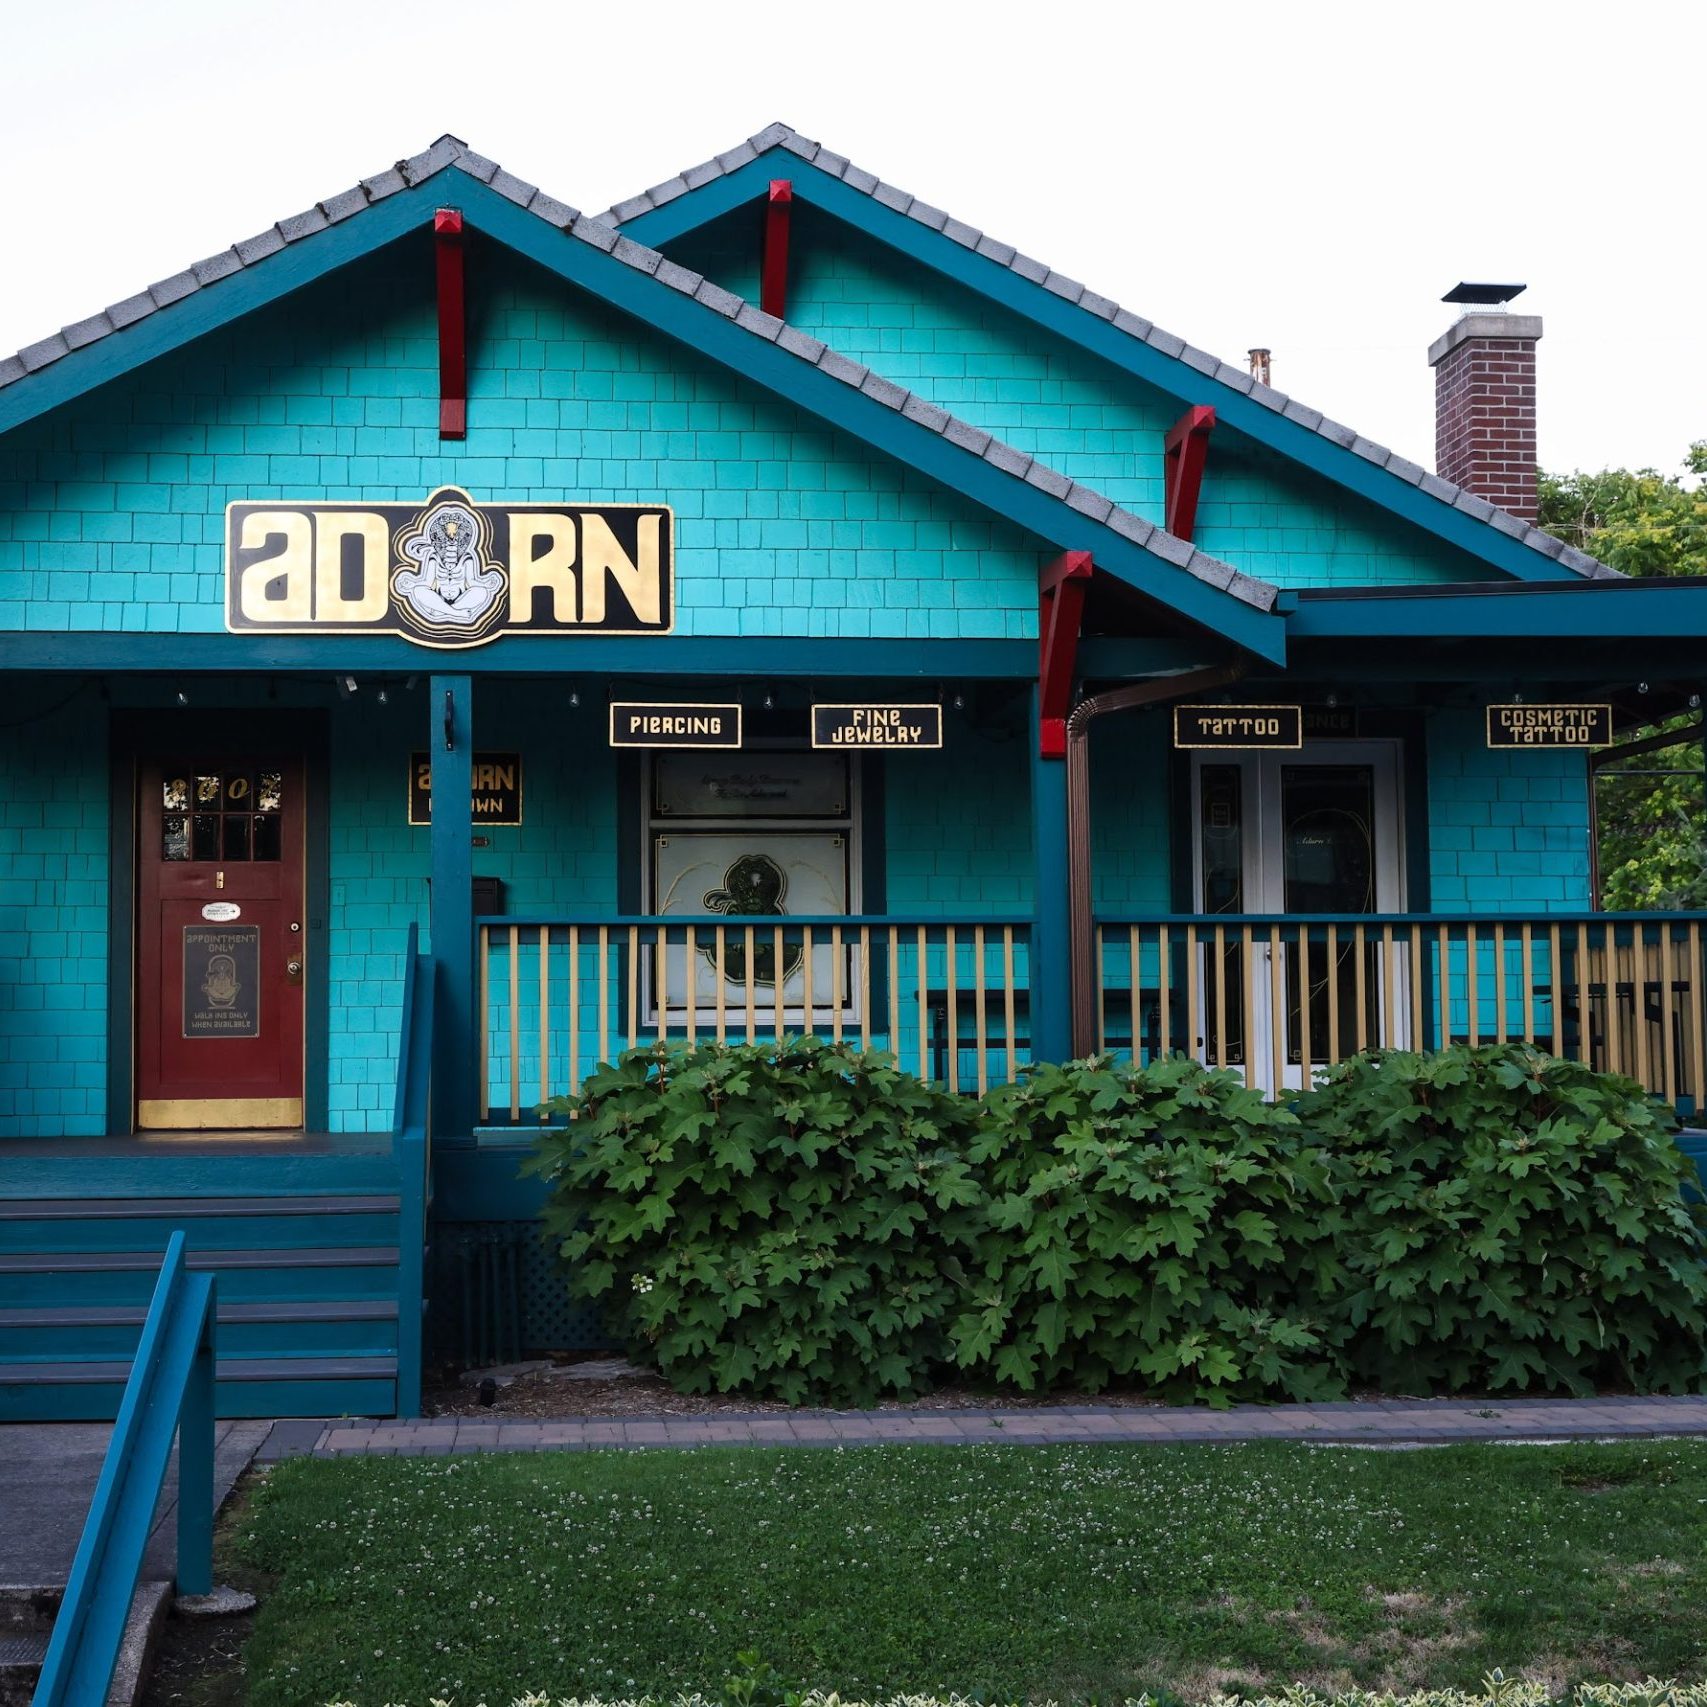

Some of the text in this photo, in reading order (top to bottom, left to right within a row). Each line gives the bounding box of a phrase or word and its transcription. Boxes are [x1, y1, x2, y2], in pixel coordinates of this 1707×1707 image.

[240, 511, 662, 624] aDRN
[208, 943, 235, 952] ONLY
[229, 1011, 248, 1019] ONLY
